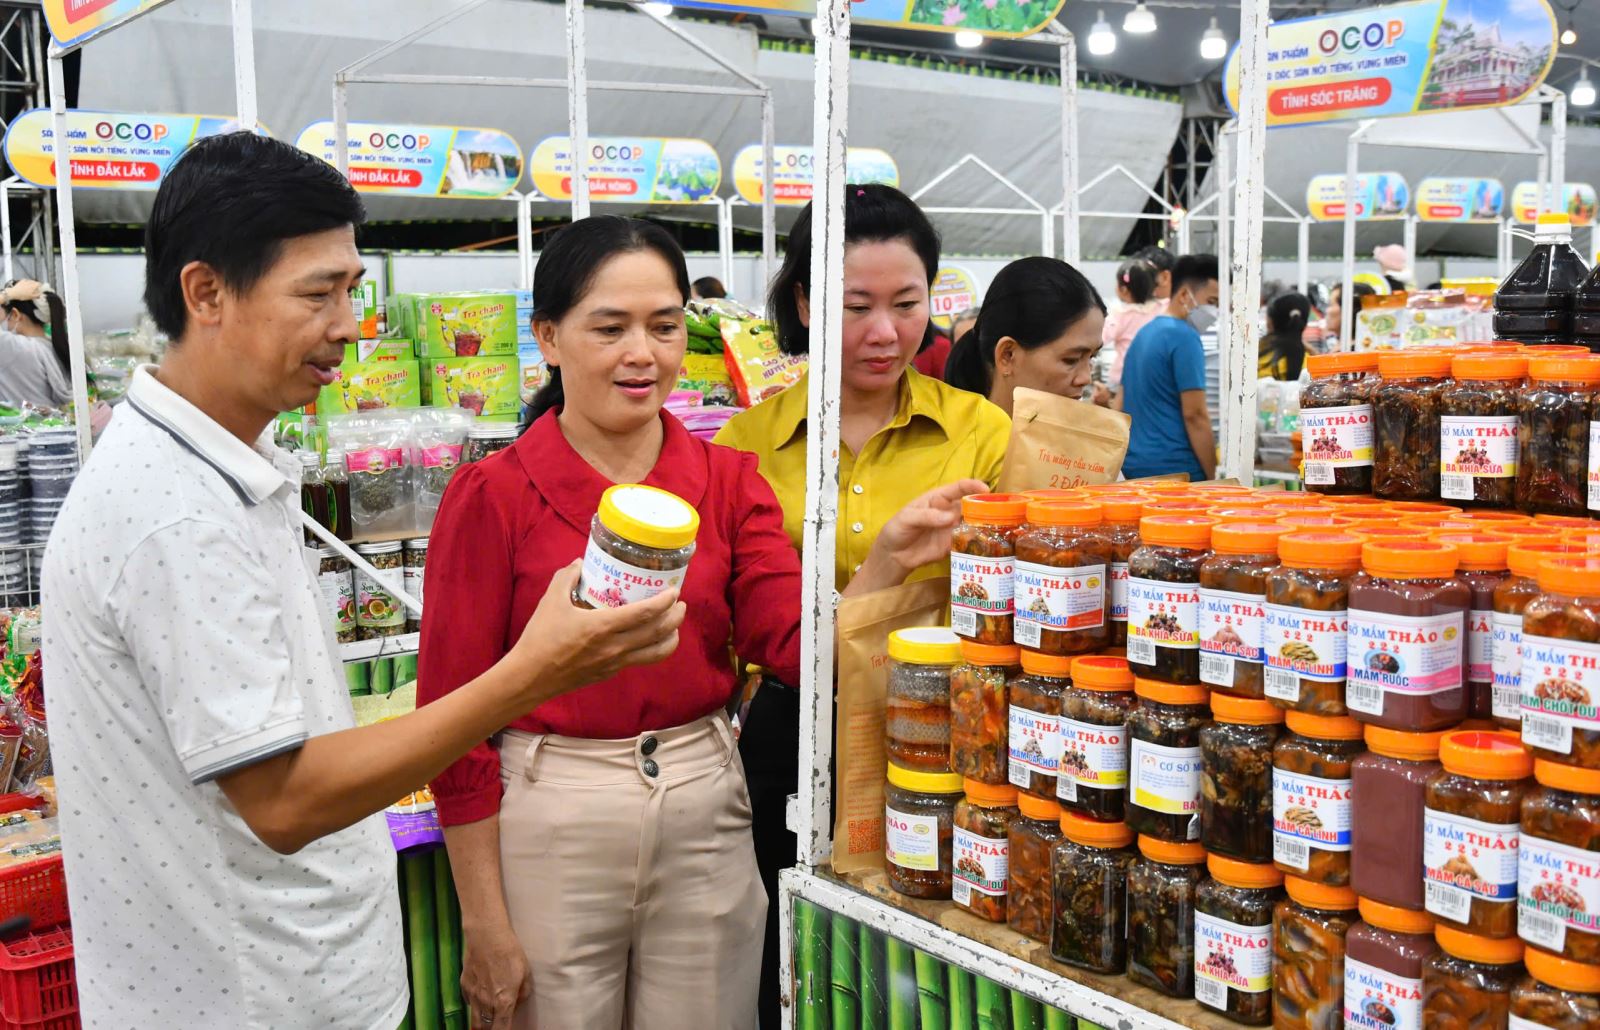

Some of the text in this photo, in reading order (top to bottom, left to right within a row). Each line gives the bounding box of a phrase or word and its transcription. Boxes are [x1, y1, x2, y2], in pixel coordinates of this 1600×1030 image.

[1319, 20, 1403, 54] OCOP
[1281, 84, 1379, 109] TỈNH SÓC TRĂNG
[95, 121, 167, 142] OCOP
[369, 132, 430, 151] OCOP
[592, 145, 643, 160] OCOP
[348, 167, 367, 182] ỈNH
[1325, 412, 1369, 427] THẢO
[1446, 463, 1457, 473] BA
[975, 562, 1014, 575] THẢO
[622, 571, 664, 588] THẢO
[1042, 577, 1082, 591] THẢO
[1143, 586, 1164, 601] MẮM
[1165, 589, 1200, 603] THẢ
[1110, 605, 1127, 615] HỐT
[1208, 599, 1266, 618] MẮM THẢ
[1278, 613, 1300, 630] MẮM
[1135, 626, 1146, 637] BA
[1361, 622, 1386, 641] MẮM
[1387, 628, 1439, 645] THẢO
[1536, 648, 1598, 670] MẮM TH
[1309, 662, 1334, 675] LINH
[1354, 664, 1410, 688] MẮM RUỐC
[1035, 719, 1060, 734] THẢ
[1076, 730, 1120, 746] THẢO
[1159, 762, 1174, 772] CƠ
[1281, 779, 1304, 795] MẮM
[1183, 801, 1197, 811] BA
[1313, 829, 1338, 842] LINH
[1437, 823, 1520, 850] MẮM THẢO
[1533, 851, 1563, 869] MẮM
[1223, 932, 1269, 950] THẢO
[1359, 973, 1383, 990] MẮM
[1384, 981, 1424, 1001] THẢ
